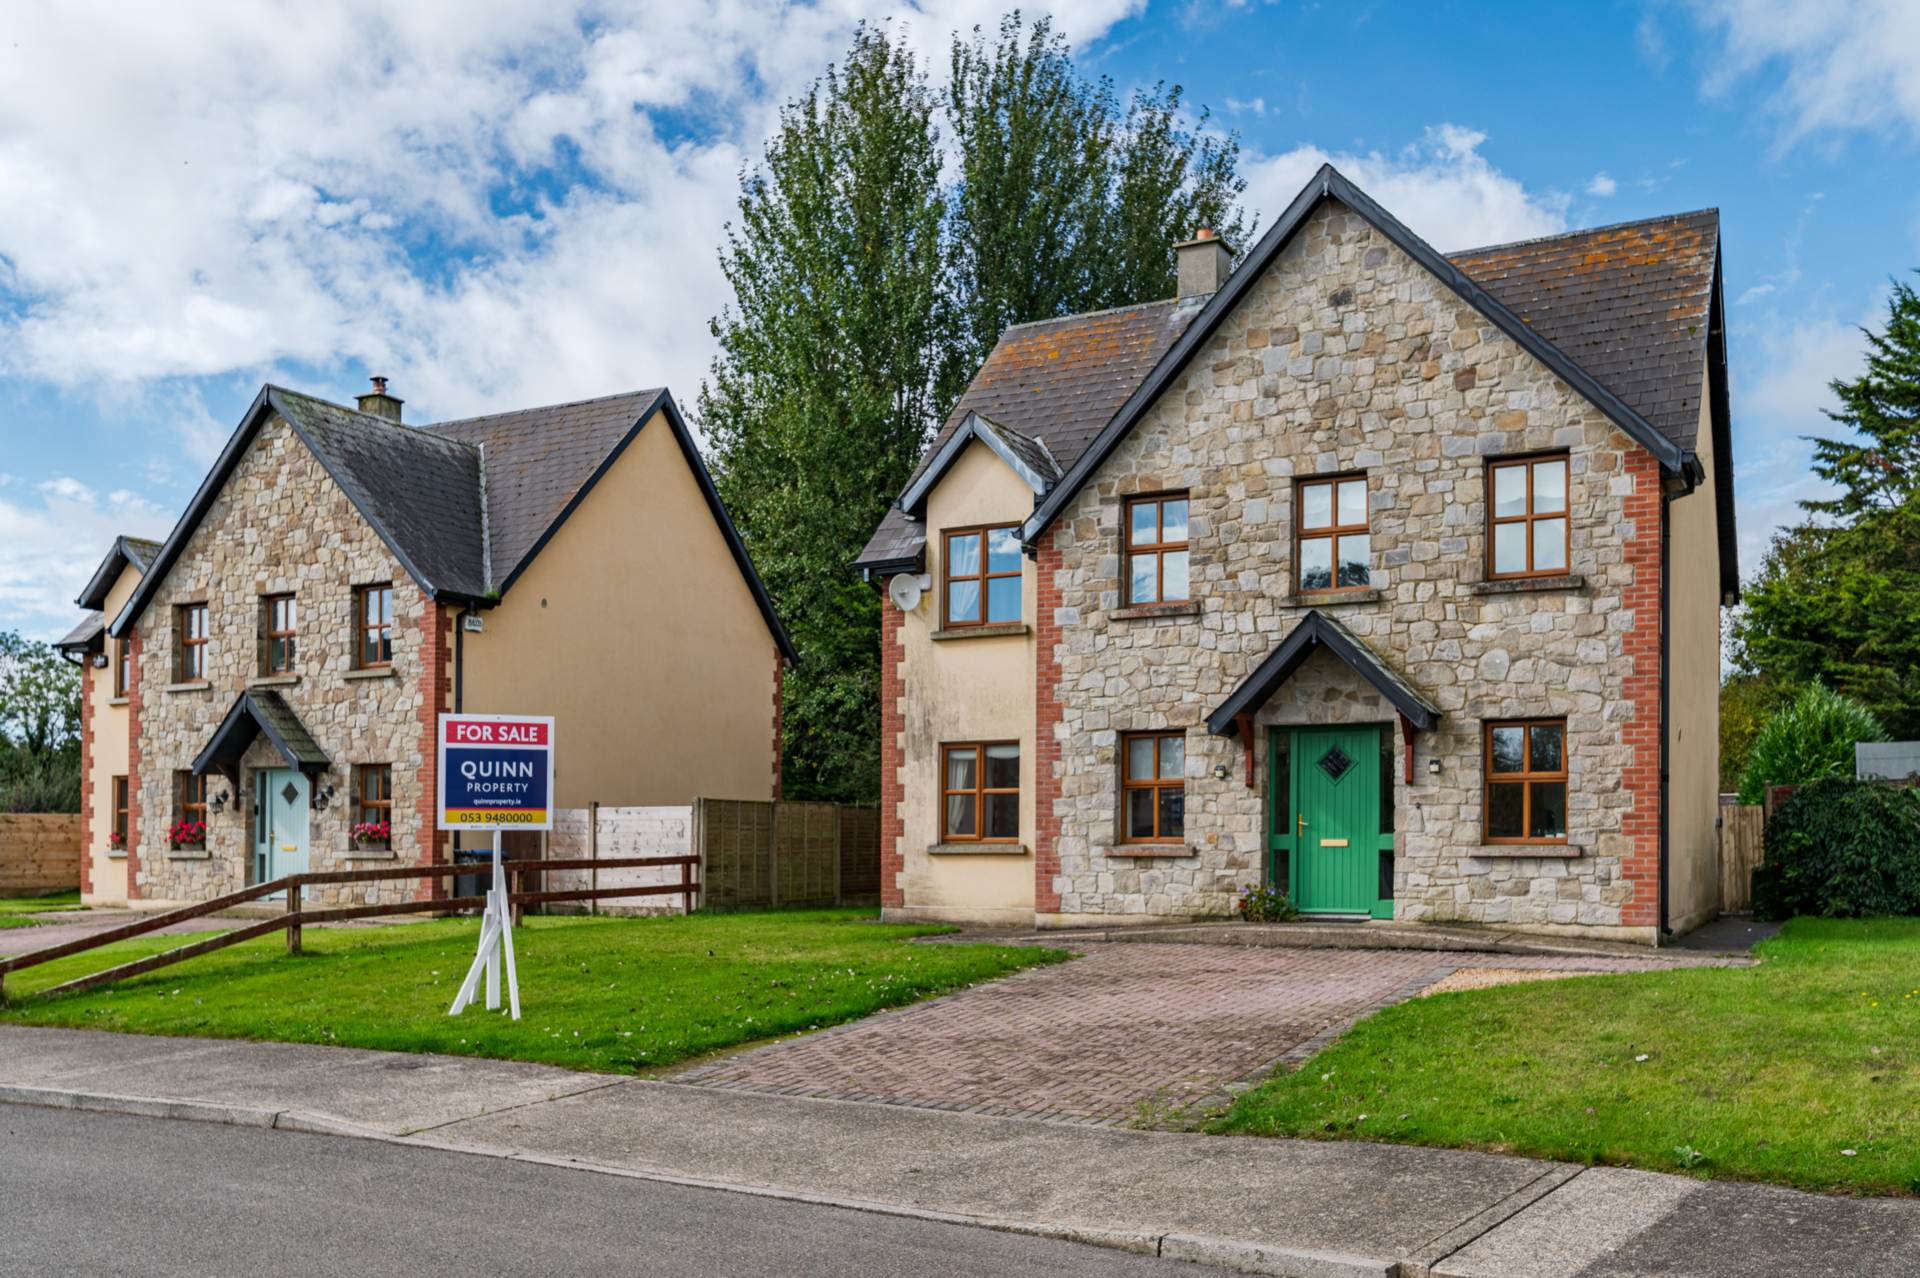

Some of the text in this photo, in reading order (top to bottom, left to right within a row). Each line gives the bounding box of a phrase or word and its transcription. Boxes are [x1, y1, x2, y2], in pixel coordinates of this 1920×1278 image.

[456, 724, 538, 743] FOR SALE
[460, 760, 533, 780] QUINN
[466, 782, 529, 793] PROPERTY
[473, 797, 521, 806] quinnproperty.ie
[460, 812, 533, 823] 053 9480000
